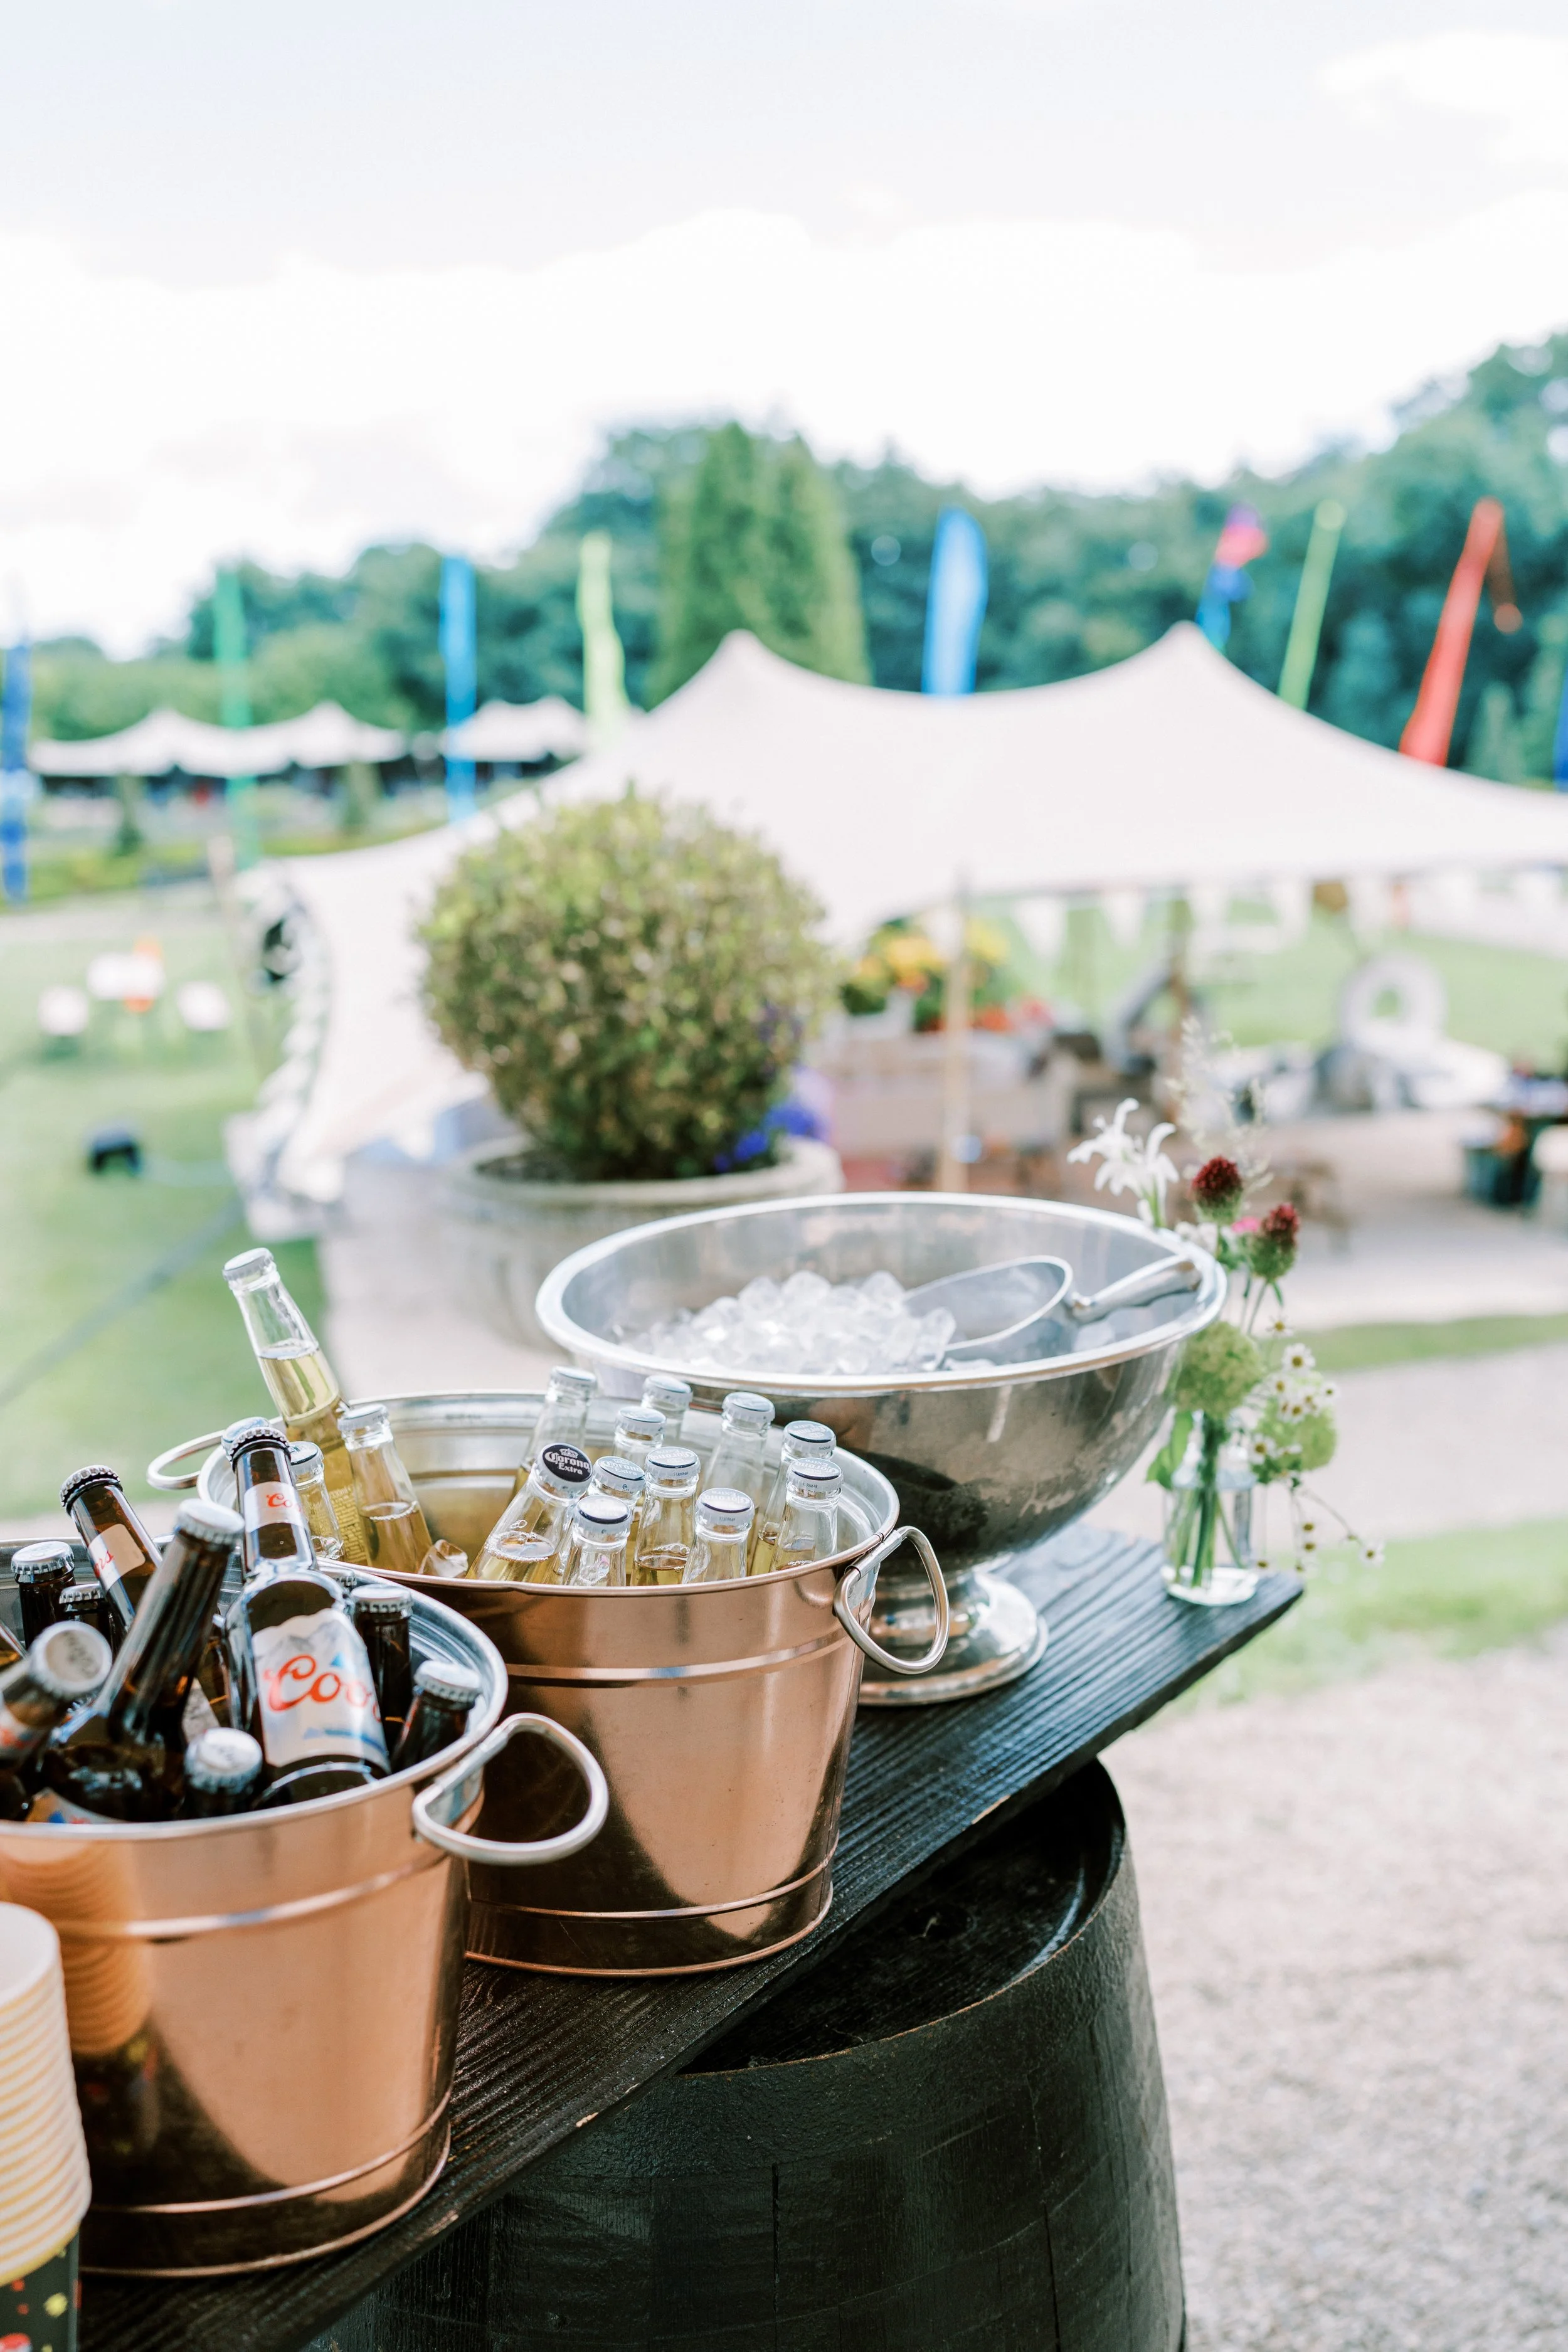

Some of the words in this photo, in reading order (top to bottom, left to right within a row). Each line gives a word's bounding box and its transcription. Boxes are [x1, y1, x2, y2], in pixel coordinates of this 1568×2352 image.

[544, 1451, 591, 1473] Corona
[558, 1463, 583, 1475] Extra
[263, 1654, 381, 1723] Coo
